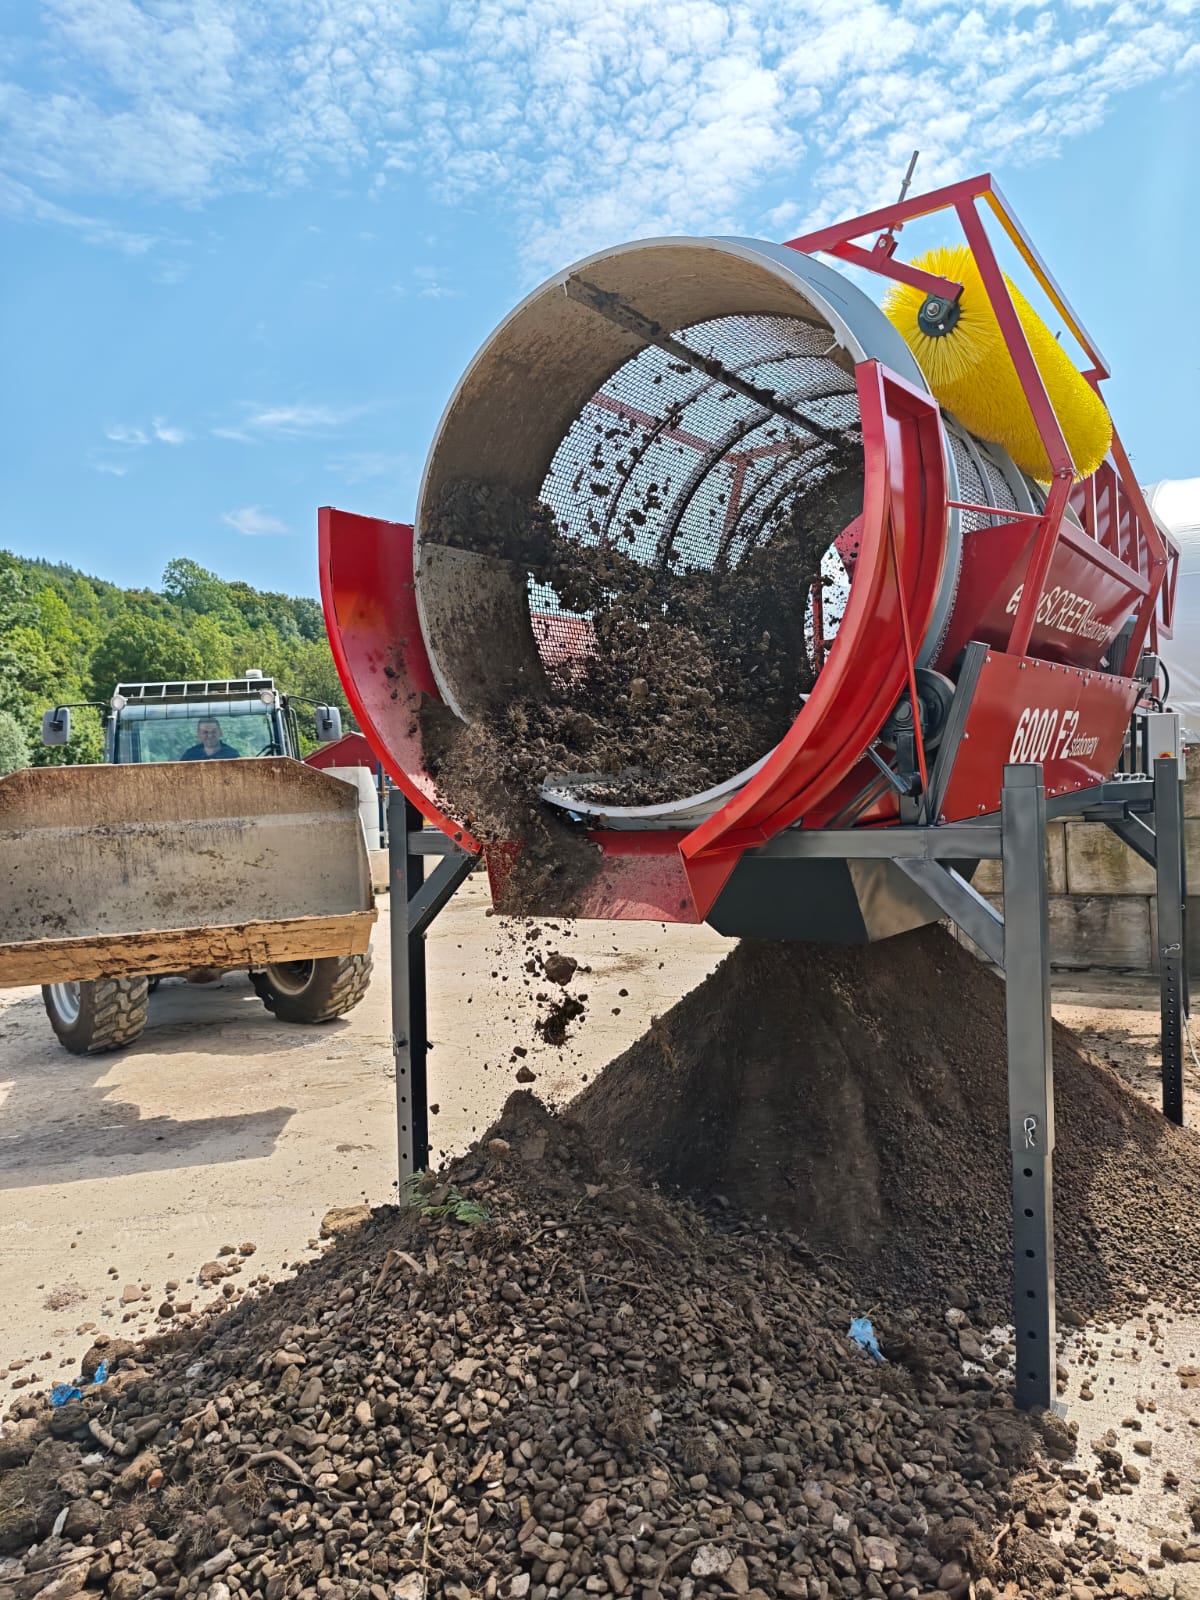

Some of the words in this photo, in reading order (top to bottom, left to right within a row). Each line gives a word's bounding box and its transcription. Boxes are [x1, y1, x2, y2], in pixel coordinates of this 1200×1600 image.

[1006, 583, 1097, 636] eySCREEN
[1009, 707, 1059, 764] 6000
[1051, 710, 1080, 761] F2
